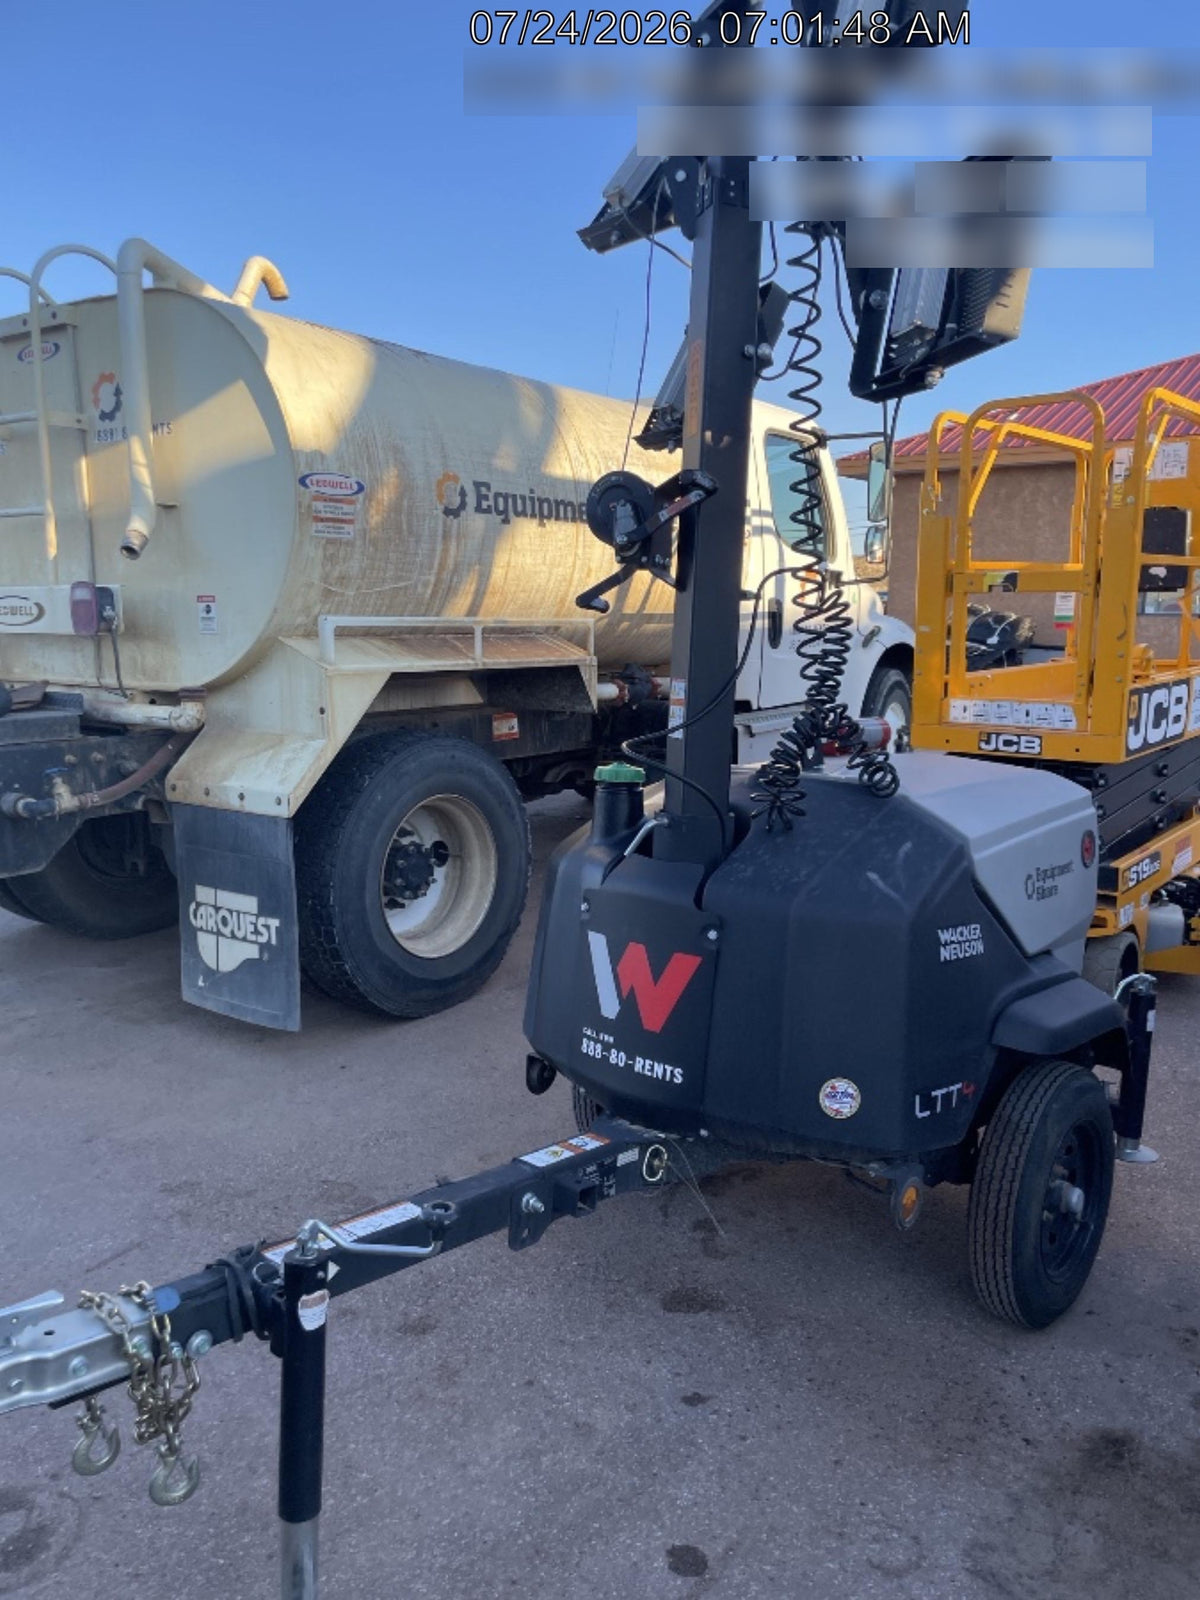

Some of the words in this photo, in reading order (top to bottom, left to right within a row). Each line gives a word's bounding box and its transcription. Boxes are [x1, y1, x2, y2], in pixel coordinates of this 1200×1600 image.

[1128, 683, 1188, 753] JCB
[979, 733, 1042, 754] JCB
[189, 901, 280, 945] CARQUEST
[938, 923, 982, 945] WACKER
[940, 940, 984, 963] NEUSON
[580, 1038, 684, 1084] 888-80-RENTS
